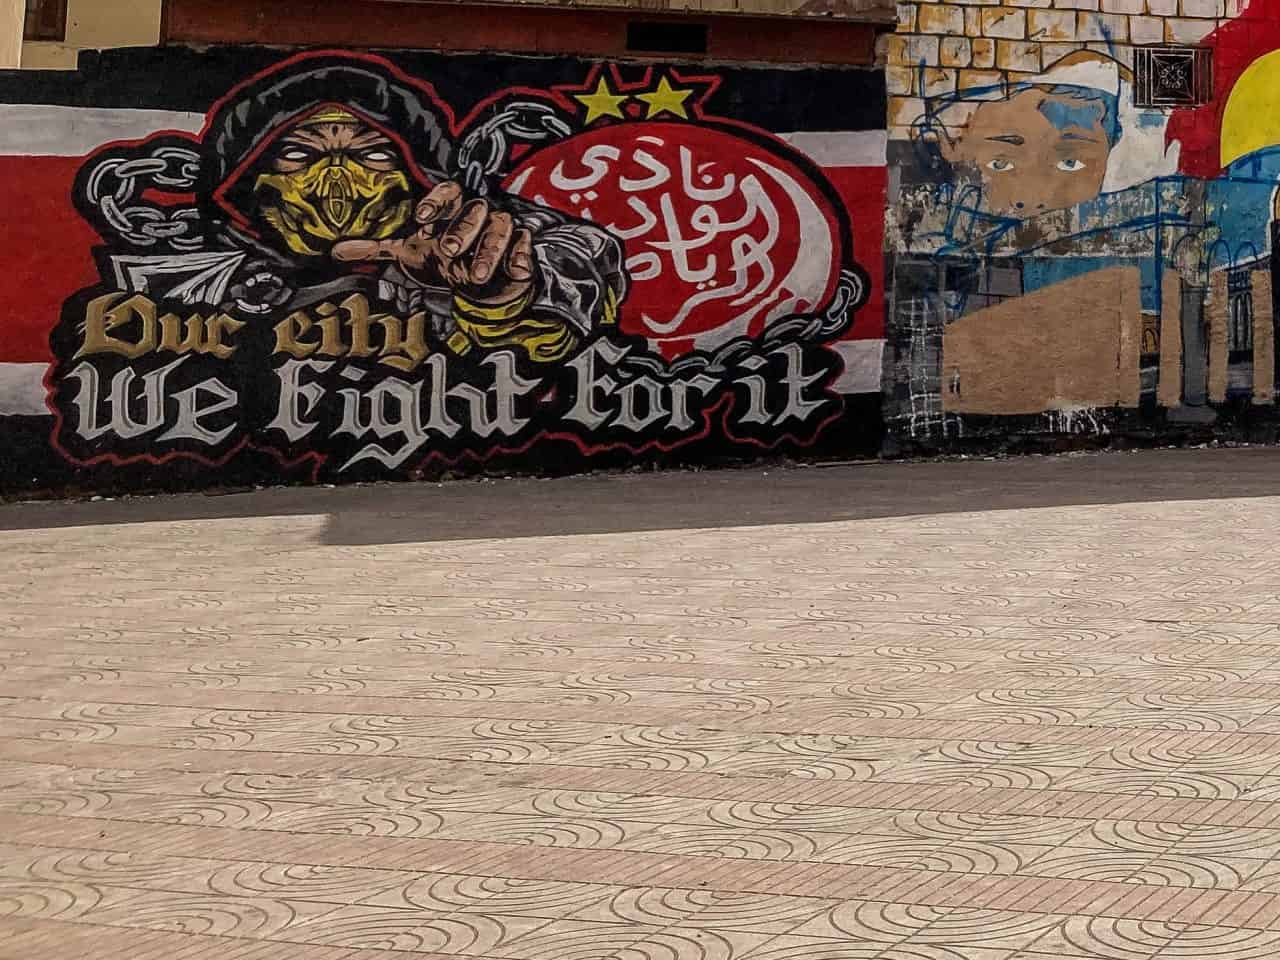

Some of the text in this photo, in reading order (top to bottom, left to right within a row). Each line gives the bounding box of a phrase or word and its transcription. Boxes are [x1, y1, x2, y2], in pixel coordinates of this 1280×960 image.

[73, 291, 431, 372] Our city
[64, 353, 238, 442] We
[733, 342, 835, 426] it
